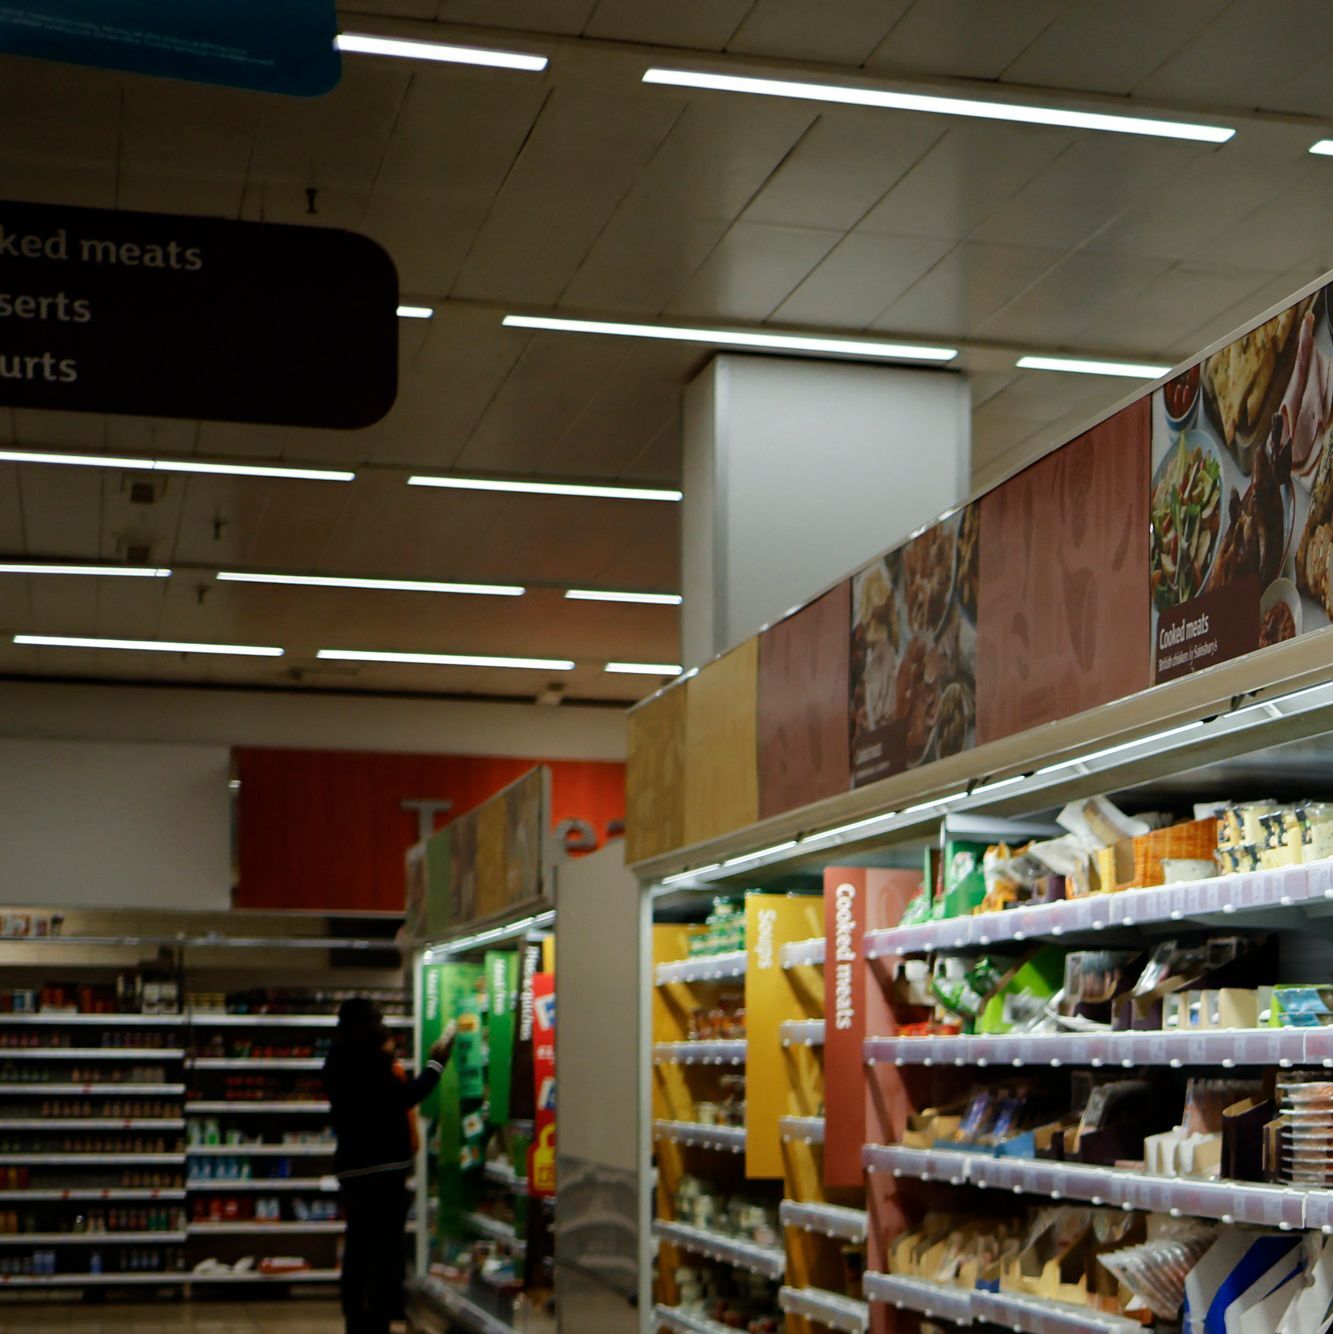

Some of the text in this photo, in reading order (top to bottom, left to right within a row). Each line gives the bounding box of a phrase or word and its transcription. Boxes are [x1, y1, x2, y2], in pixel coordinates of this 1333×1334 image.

[0, 225, 203, 270] ked meats
[0, 292, 91, 322] serts
[0, 352, 78, 382] urts
[1159, 612, 1209, 650] Cooked meats
[836, 883, 857, 1030] Cooked meats
